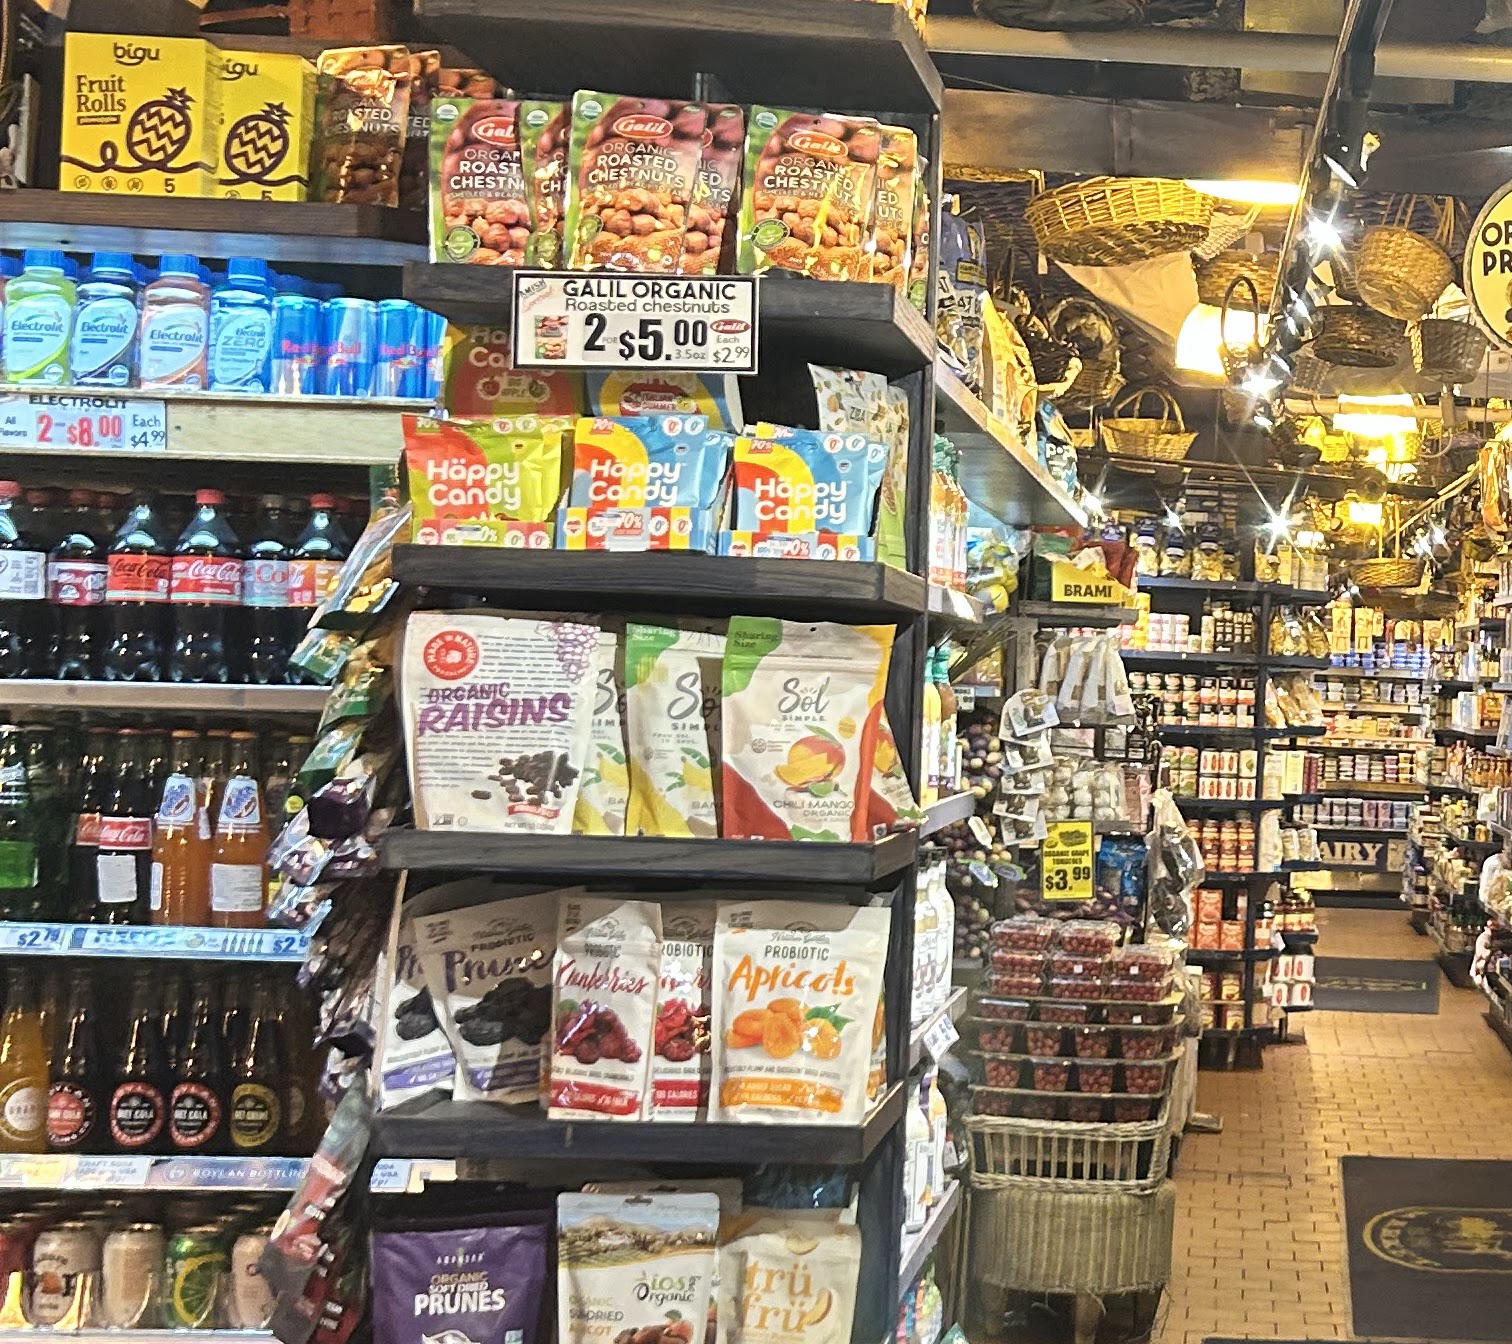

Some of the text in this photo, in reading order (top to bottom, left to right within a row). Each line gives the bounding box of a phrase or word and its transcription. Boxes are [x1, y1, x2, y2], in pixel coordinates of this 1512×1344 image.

[113, 42, 160, 66] bigu
[222, 60, 259, 80] igu
[76, 75, 126, 93] Fruit
[76, 94, 127, 113] Rolls
[478, 125, 515, 140] Gal
[619, 118, 665, 133] Galil
[465, 149, 521, 161] ORGA
[597, 155, 677, 172] ROASTED
[460, 161, 519, 174] ROAST
[164, 179, 176, 194] 5
[450, 175, 525, 190] CHESTN
[589, 168, 684, 188] CHESTNUTS
[774, 165, 854, 191] ROASTED
[563, 280, 736, 300] GALIL ORGANIC
[565, 298, 637, 312] Roasted
[642, 298, 730, 313] chestnuts
[12, 321, 64, 332] Electrolit
[82, 322, 128, 333] Electrolit
[584, 313, 608, 351] 2
[151, 330, 203, 342] Electrolit
[221, 336, 265, 348] ZERO
[716, 335, 740, 344] Each
[675, 349, 706, 360] 3.5oz
[133, 415, 161, 427] Each
[428, 484, 521, 511] Candy
[588, 479, 680, 506] Candy
[755, 501, 847, 524] Candy
[1064, 584, 1112, 598] BRAMI
[428, 682, 511, 704] ORGANIC
[779, 677, 830, 714] Sol
[417, 693, 572, 737] RAISINS
[808, 800, 854, 809] MANGO
[1320, 841, 1383, 862] AIRY
[1045, 867, 1091, 891] $3.99
[765, 945, 829, 961] PROBIOTIC
[728, 954, 856, 1002] Apricots
[431, 1272, 488, 1285] ORGANIC
[414, 1288, 506, 1317] PRUNES
[633, 1282, 695, 1307] Organic
